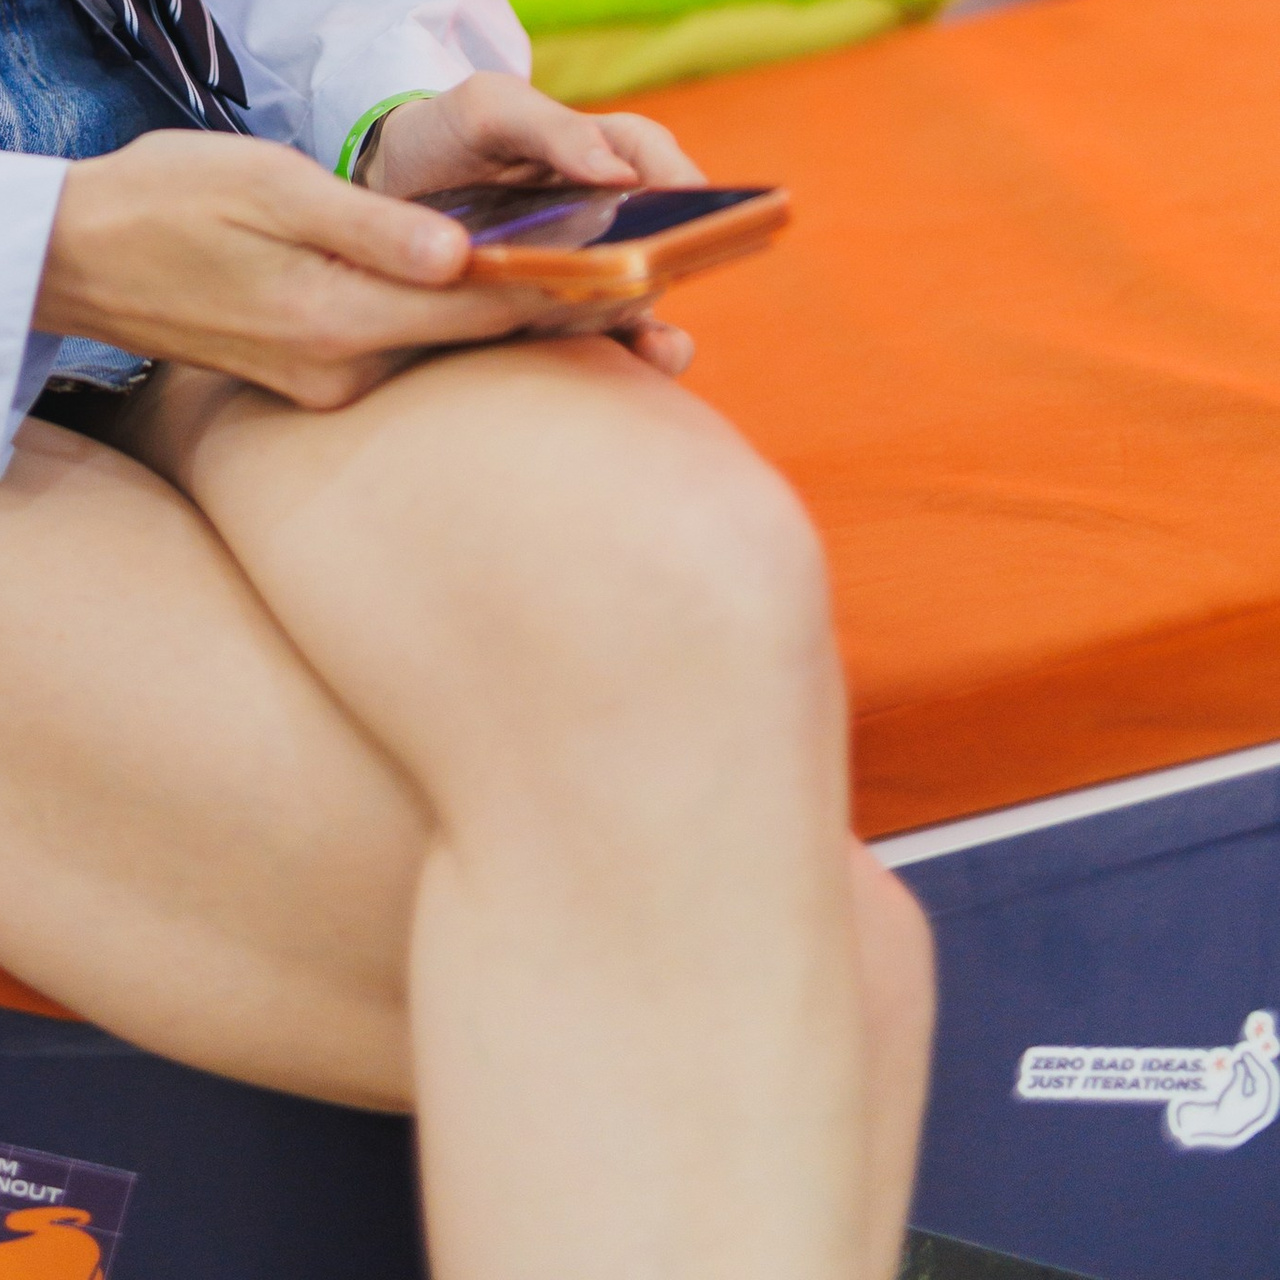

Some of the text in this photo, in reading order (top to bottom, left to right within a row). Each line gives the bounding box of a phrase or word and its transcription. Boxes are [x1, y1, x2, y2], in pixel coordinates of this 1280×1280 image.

[1030, 1056, 1207, 1073] ZERO BAD IDEAS.
[1028, 1075, 1208, 1092] JUST ITERATIONS.
